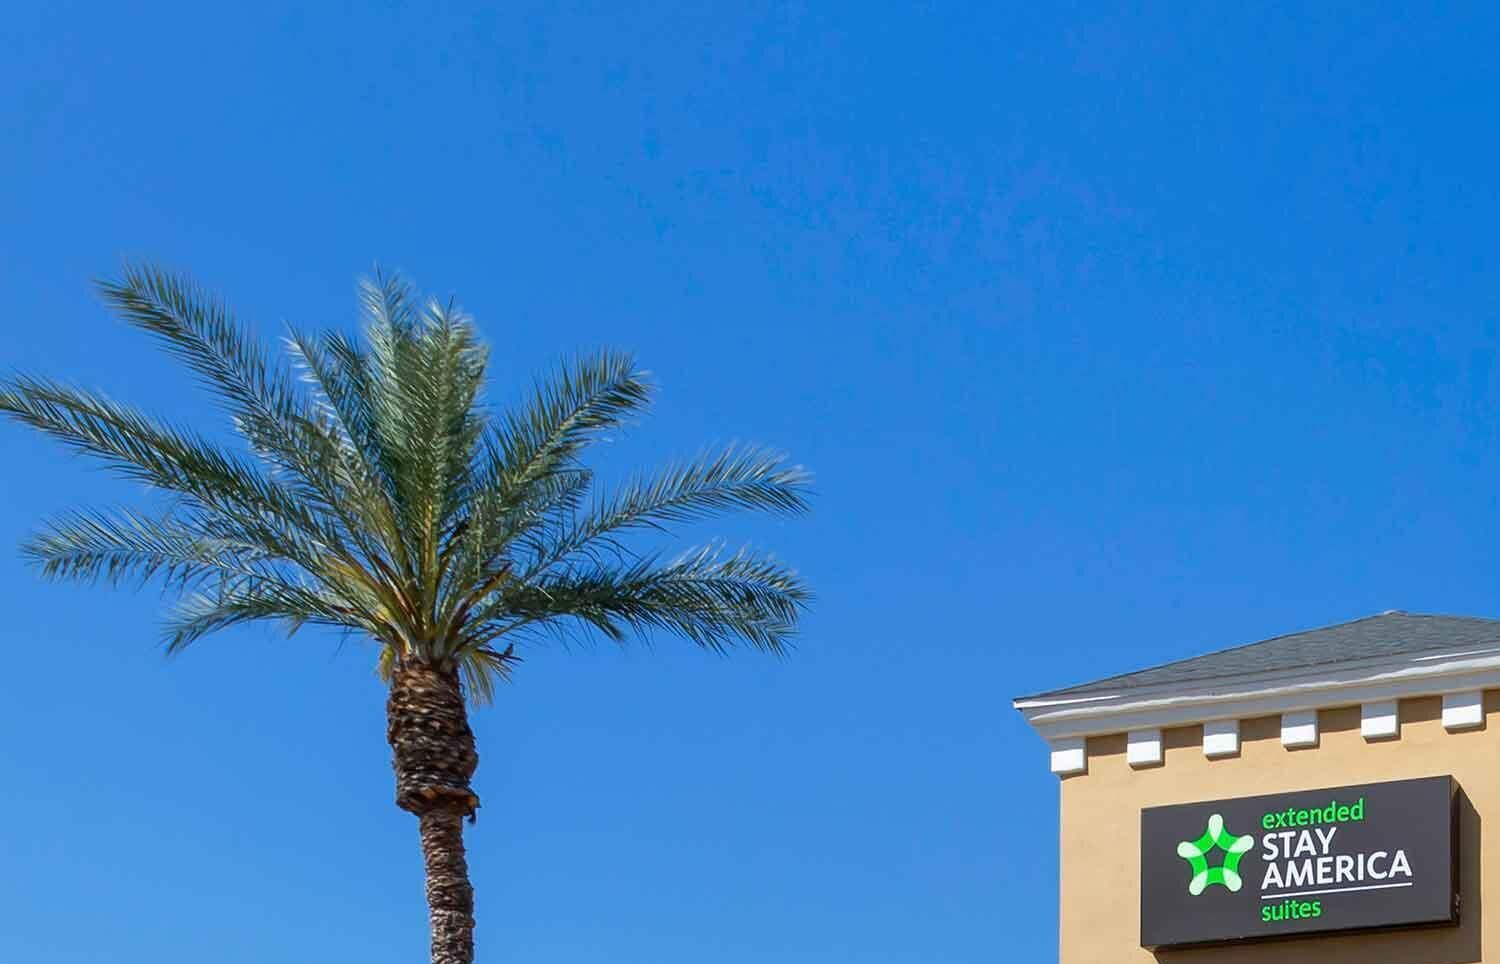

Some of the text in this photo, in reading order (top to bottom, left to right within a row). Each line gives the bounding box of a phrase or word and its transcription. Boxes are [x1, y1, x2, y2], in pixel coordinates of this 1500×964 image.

[1262, 798, 1364, 829] extended
[1262, 827, 1337, 861] STAY
[1261, 850, 1413, 890] AMERICA
[1262, 900, 1321, 922] suites
